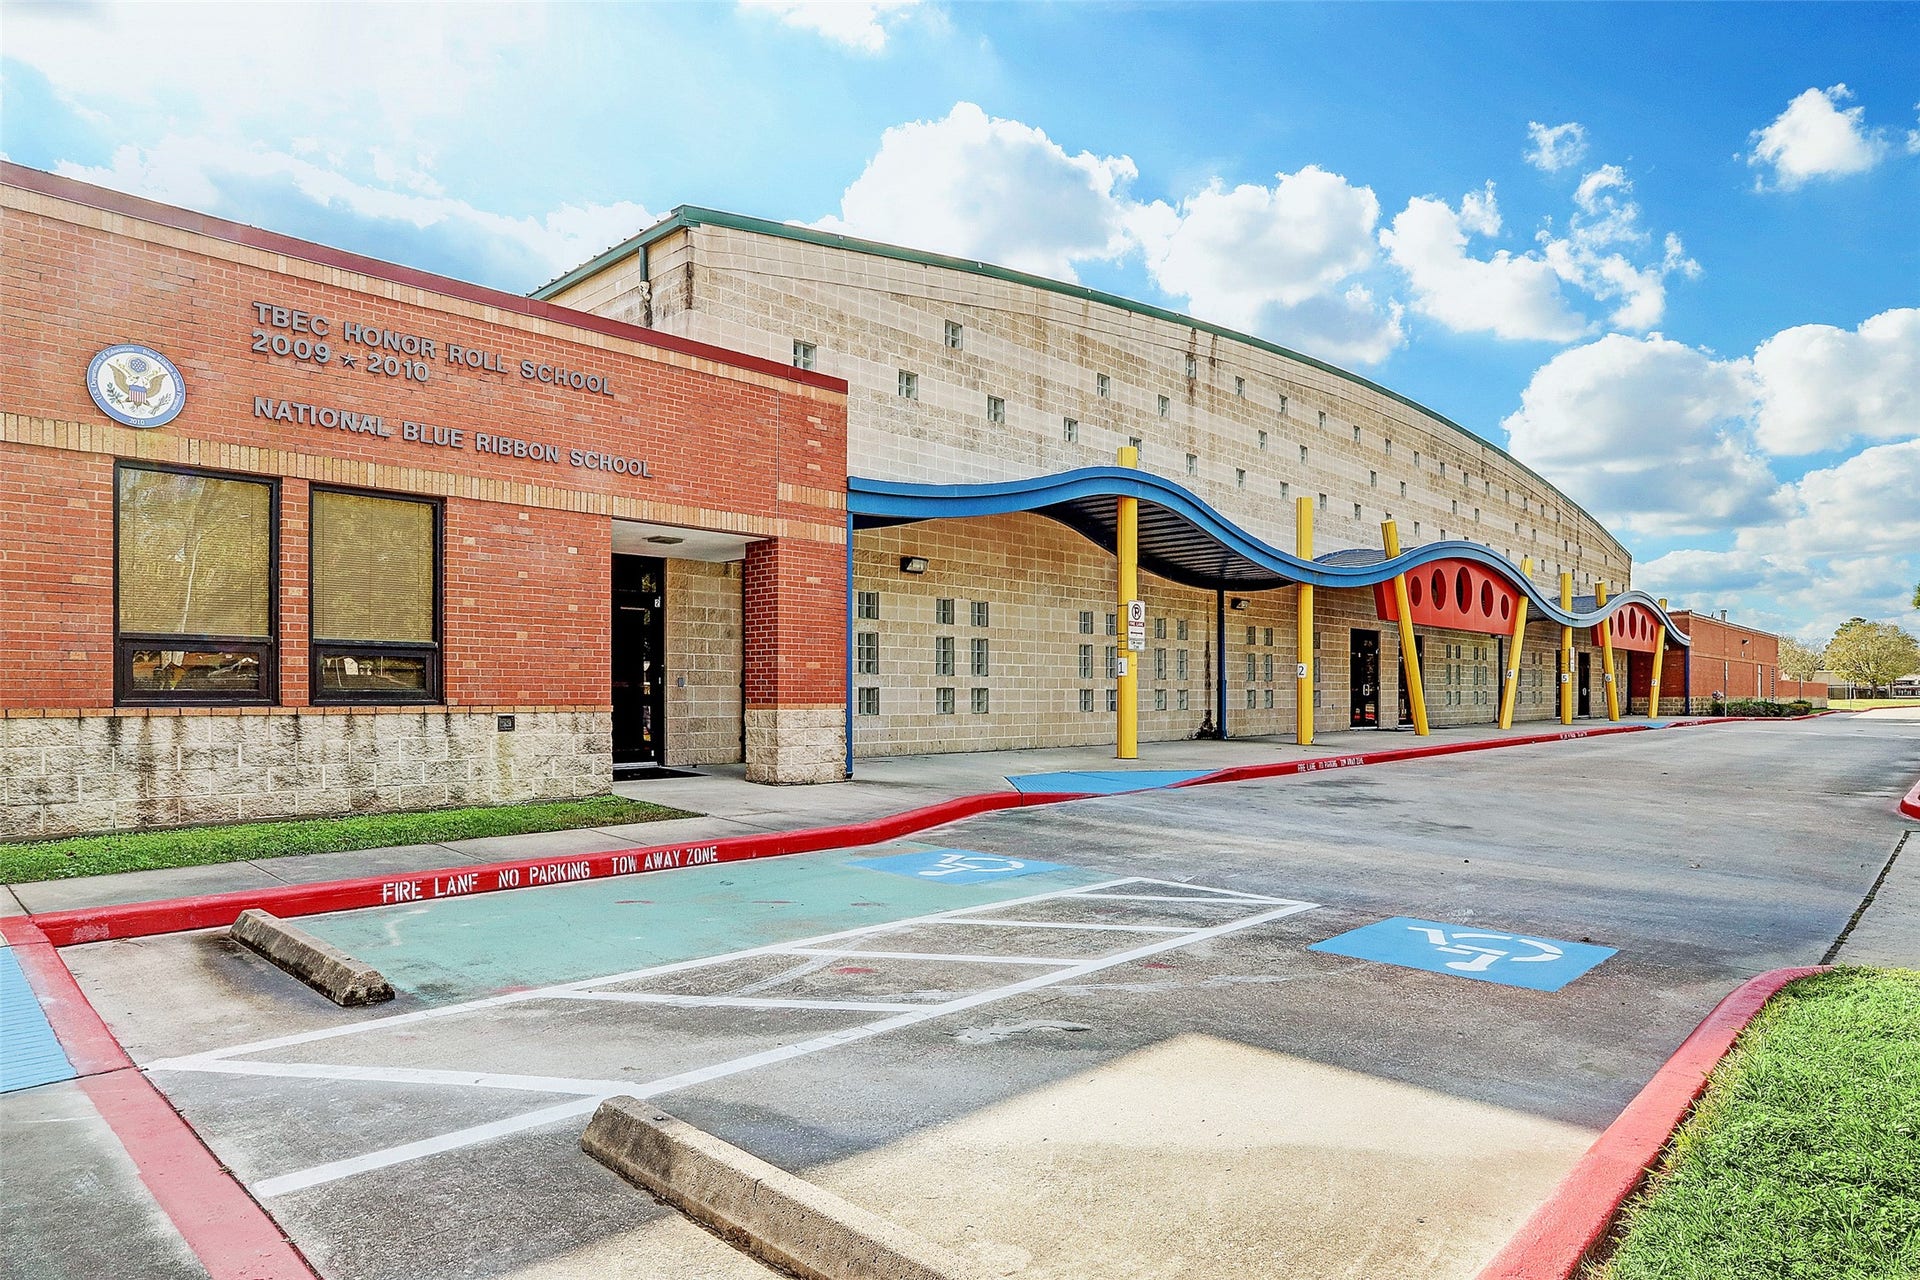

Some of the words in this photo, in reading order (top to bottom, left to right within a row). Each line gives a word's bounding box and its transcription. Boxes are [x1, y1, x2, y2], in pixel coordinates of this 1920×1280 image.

[252, 301, 330, 337] TBEC
[344, 321, 436, 359] HONOR
[447, 343, 508, 374] ROLL
[520, 359, 615, 396] SCHOOL
[252, 329, 331, 364] 2009
[367, 352, 430, 382] 2010
[254, 396, 391, 438] NATIONAL
[403, 420, 464, 448] BLUE
[475, 432, 560, 464] RIBBON
[570, 449, 653, 478] SCHOOL
[1118, 661, 1124, 674] 1
[1298, 665, 1305, 676] 2
[1562, 674, 1567, 682] 5
[382, 880, 423, 903] FIRE
[498, 869, 520, 889] NO
[529, 861, 590, 886] PARKING
[612, 856, 637, 875] TOW
[644, 849, 681, 870] AWAY
[687, 846, 719, 863] ZONE
